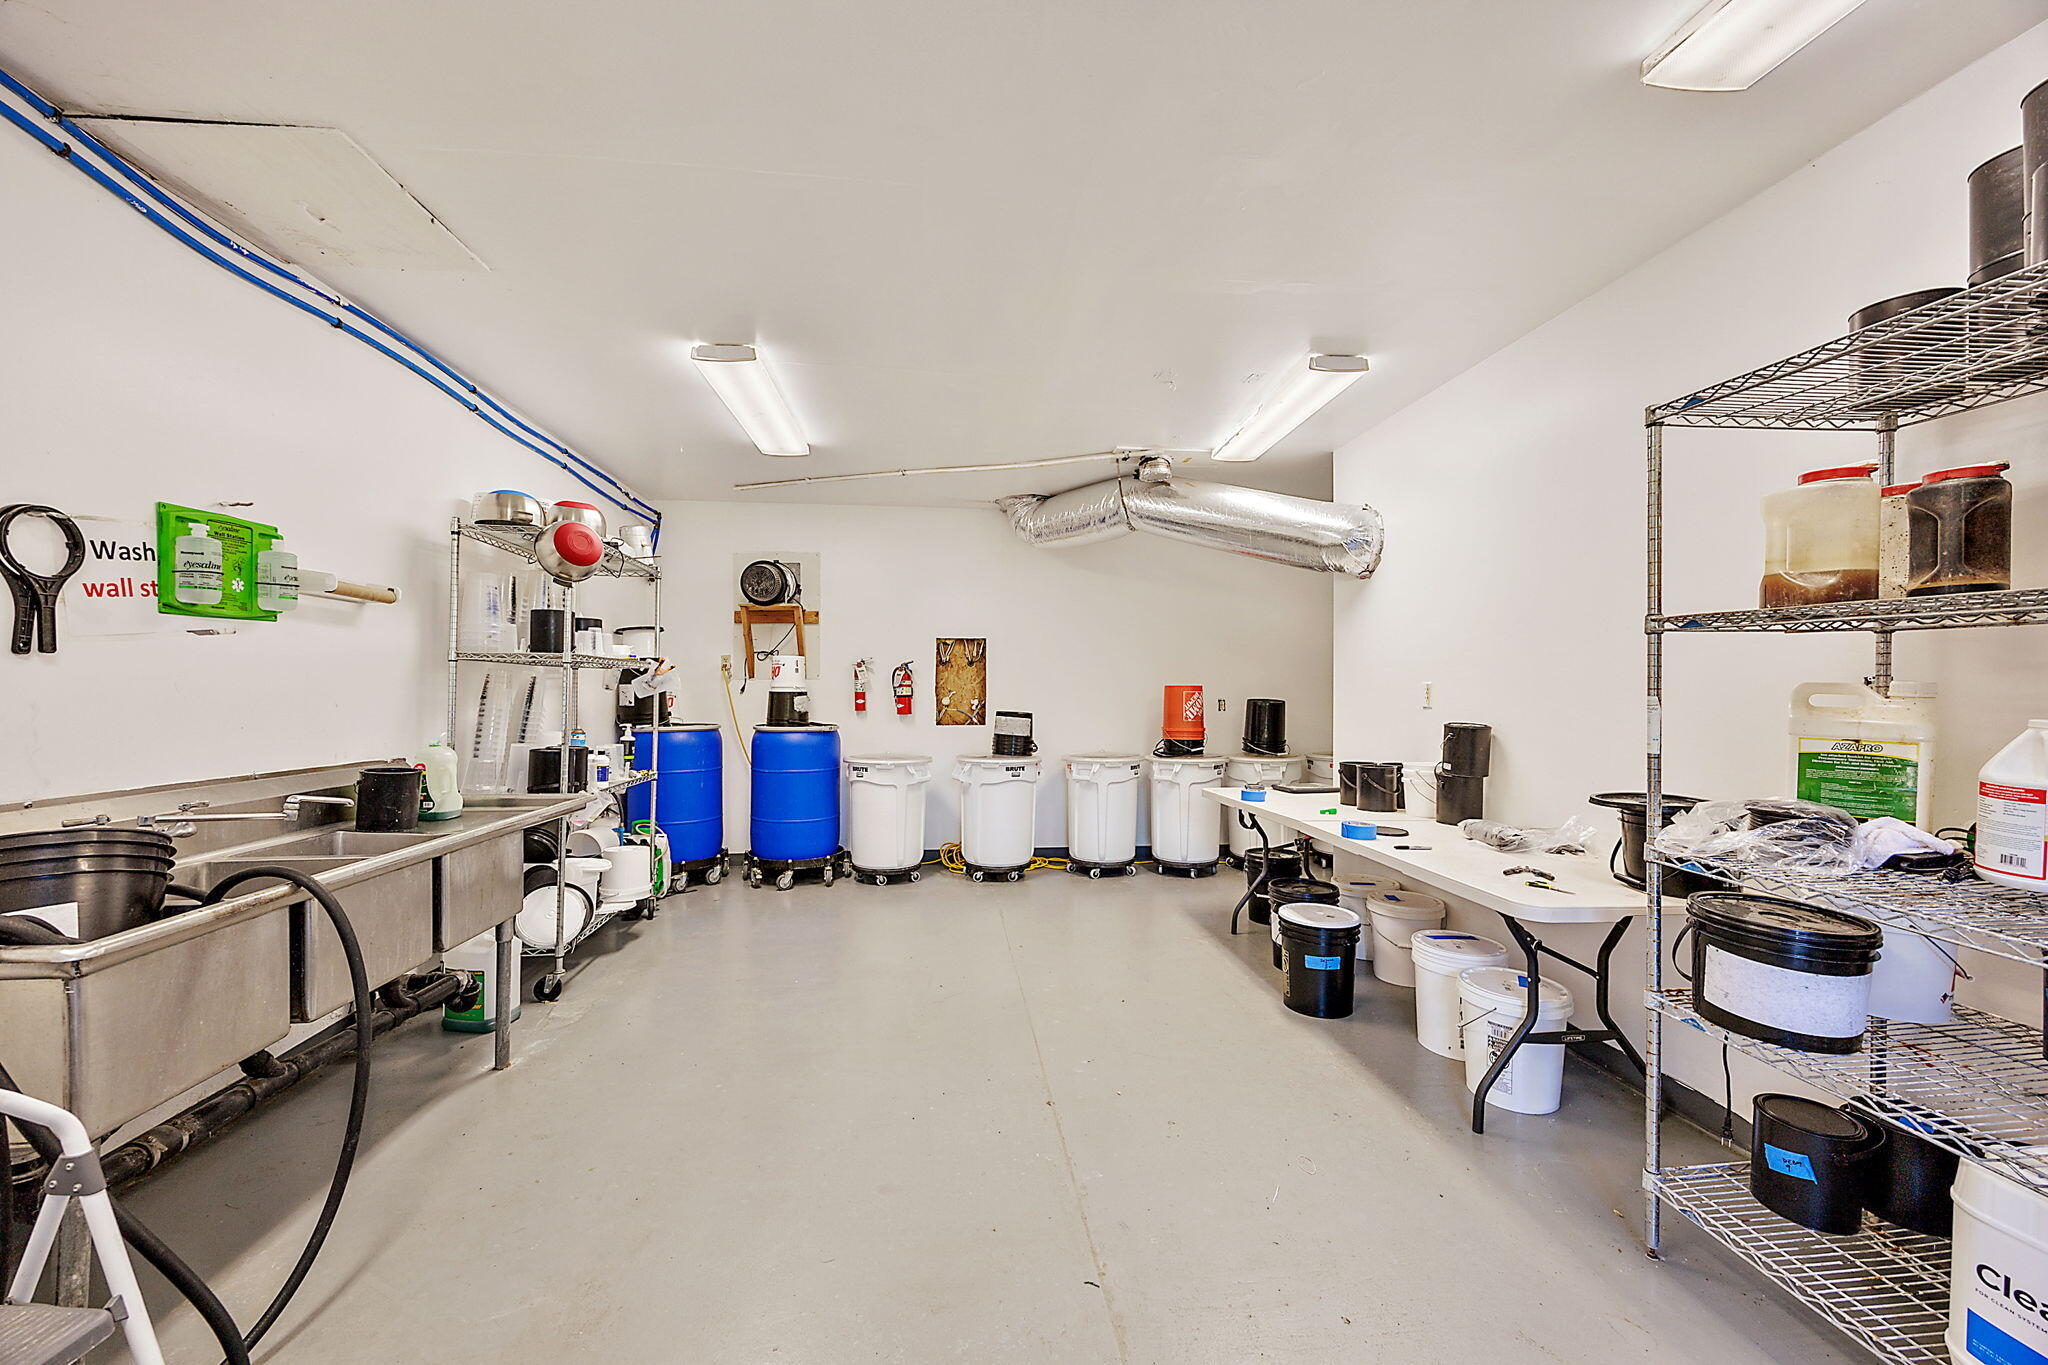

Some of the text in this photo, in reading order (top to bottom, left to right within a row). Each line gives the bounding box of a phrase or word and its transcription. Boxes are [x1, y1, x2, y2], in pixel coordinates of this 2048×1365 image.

[89, 540, 156, 561] Wash
[82, 577, 133, 597] wall
[140, 580, 158, 597] st
[1831, 742, 1883, 752] AZAPRO
[1975, 1288, 1989, 1299] FOR
[1991, 1298, 2015, 1315] CLEAN
